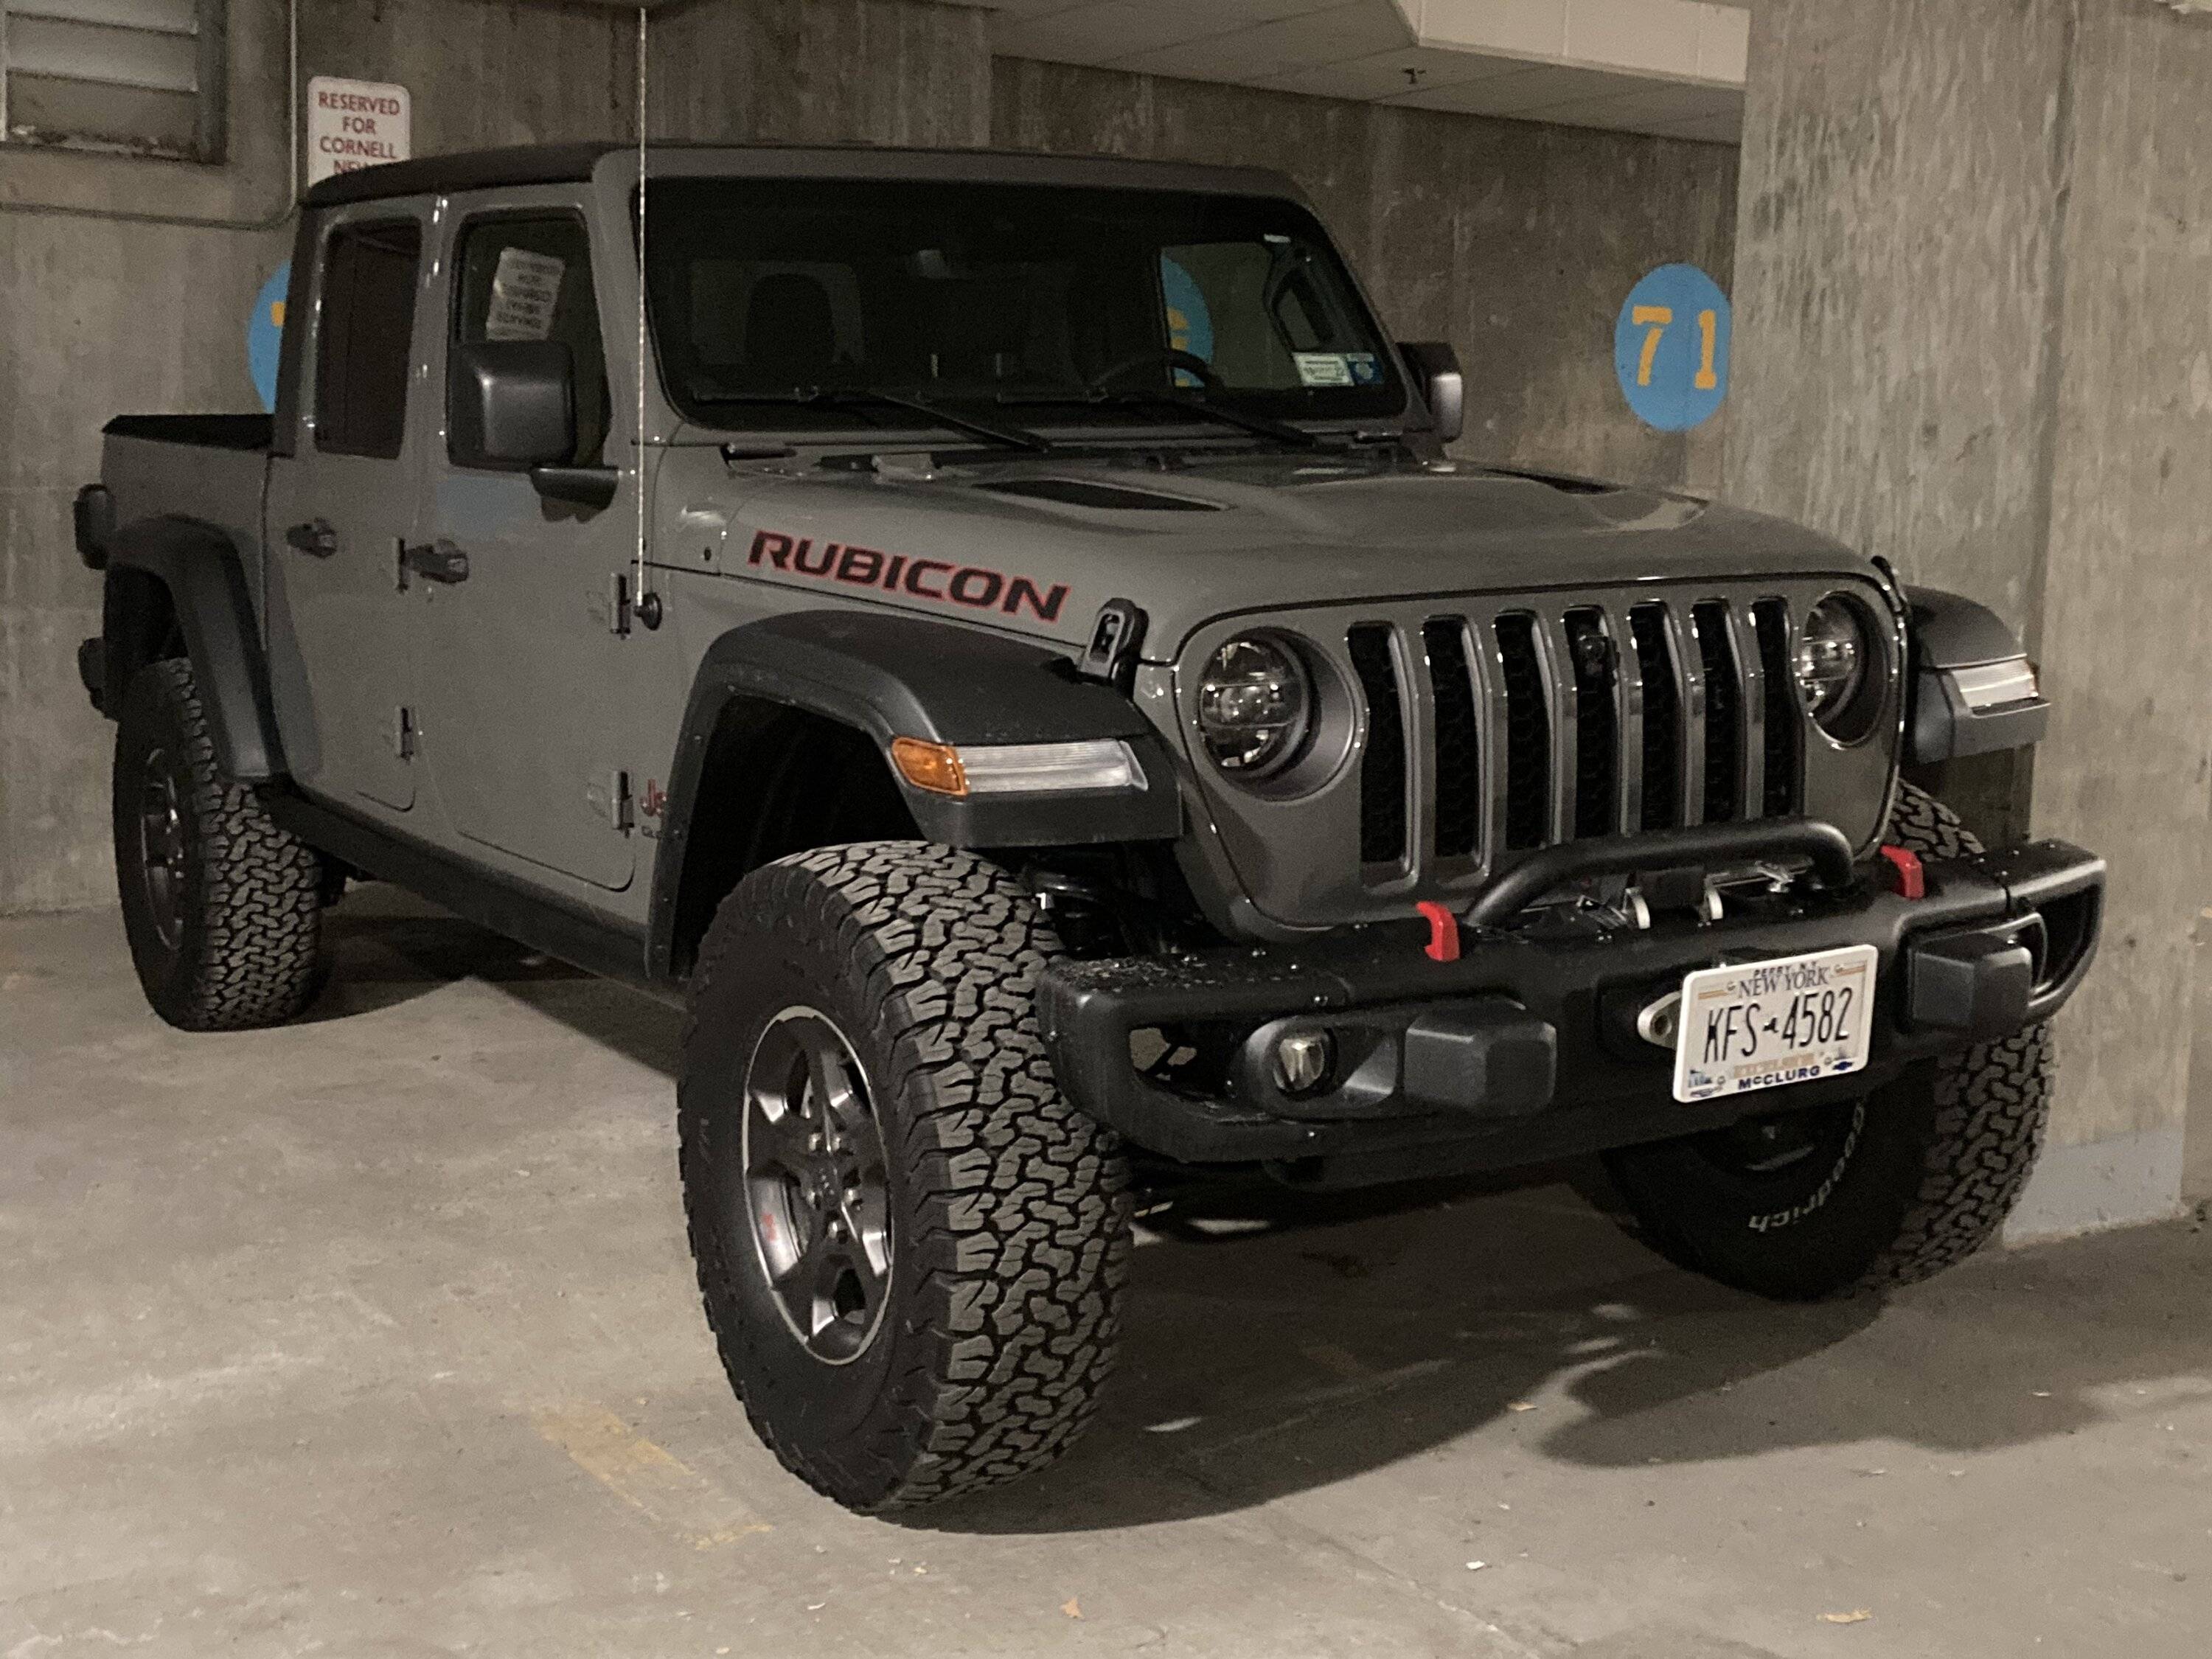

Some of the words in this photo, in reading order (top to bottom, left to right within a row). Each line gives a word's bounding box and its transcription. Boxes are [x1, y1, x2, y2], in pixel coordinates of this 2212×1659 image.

[319, 91, 400, 115] RESERVED
[342, 116, 376, 134] FOR
[320, 136, 397, 159] CORNELL
[1632, 305, 1717, 389] 71
[748, 530, 1071, 624] RUBICON
[1737, 975, 1779, 998] NEW
[1783, 966, 1830, 992] YORK
